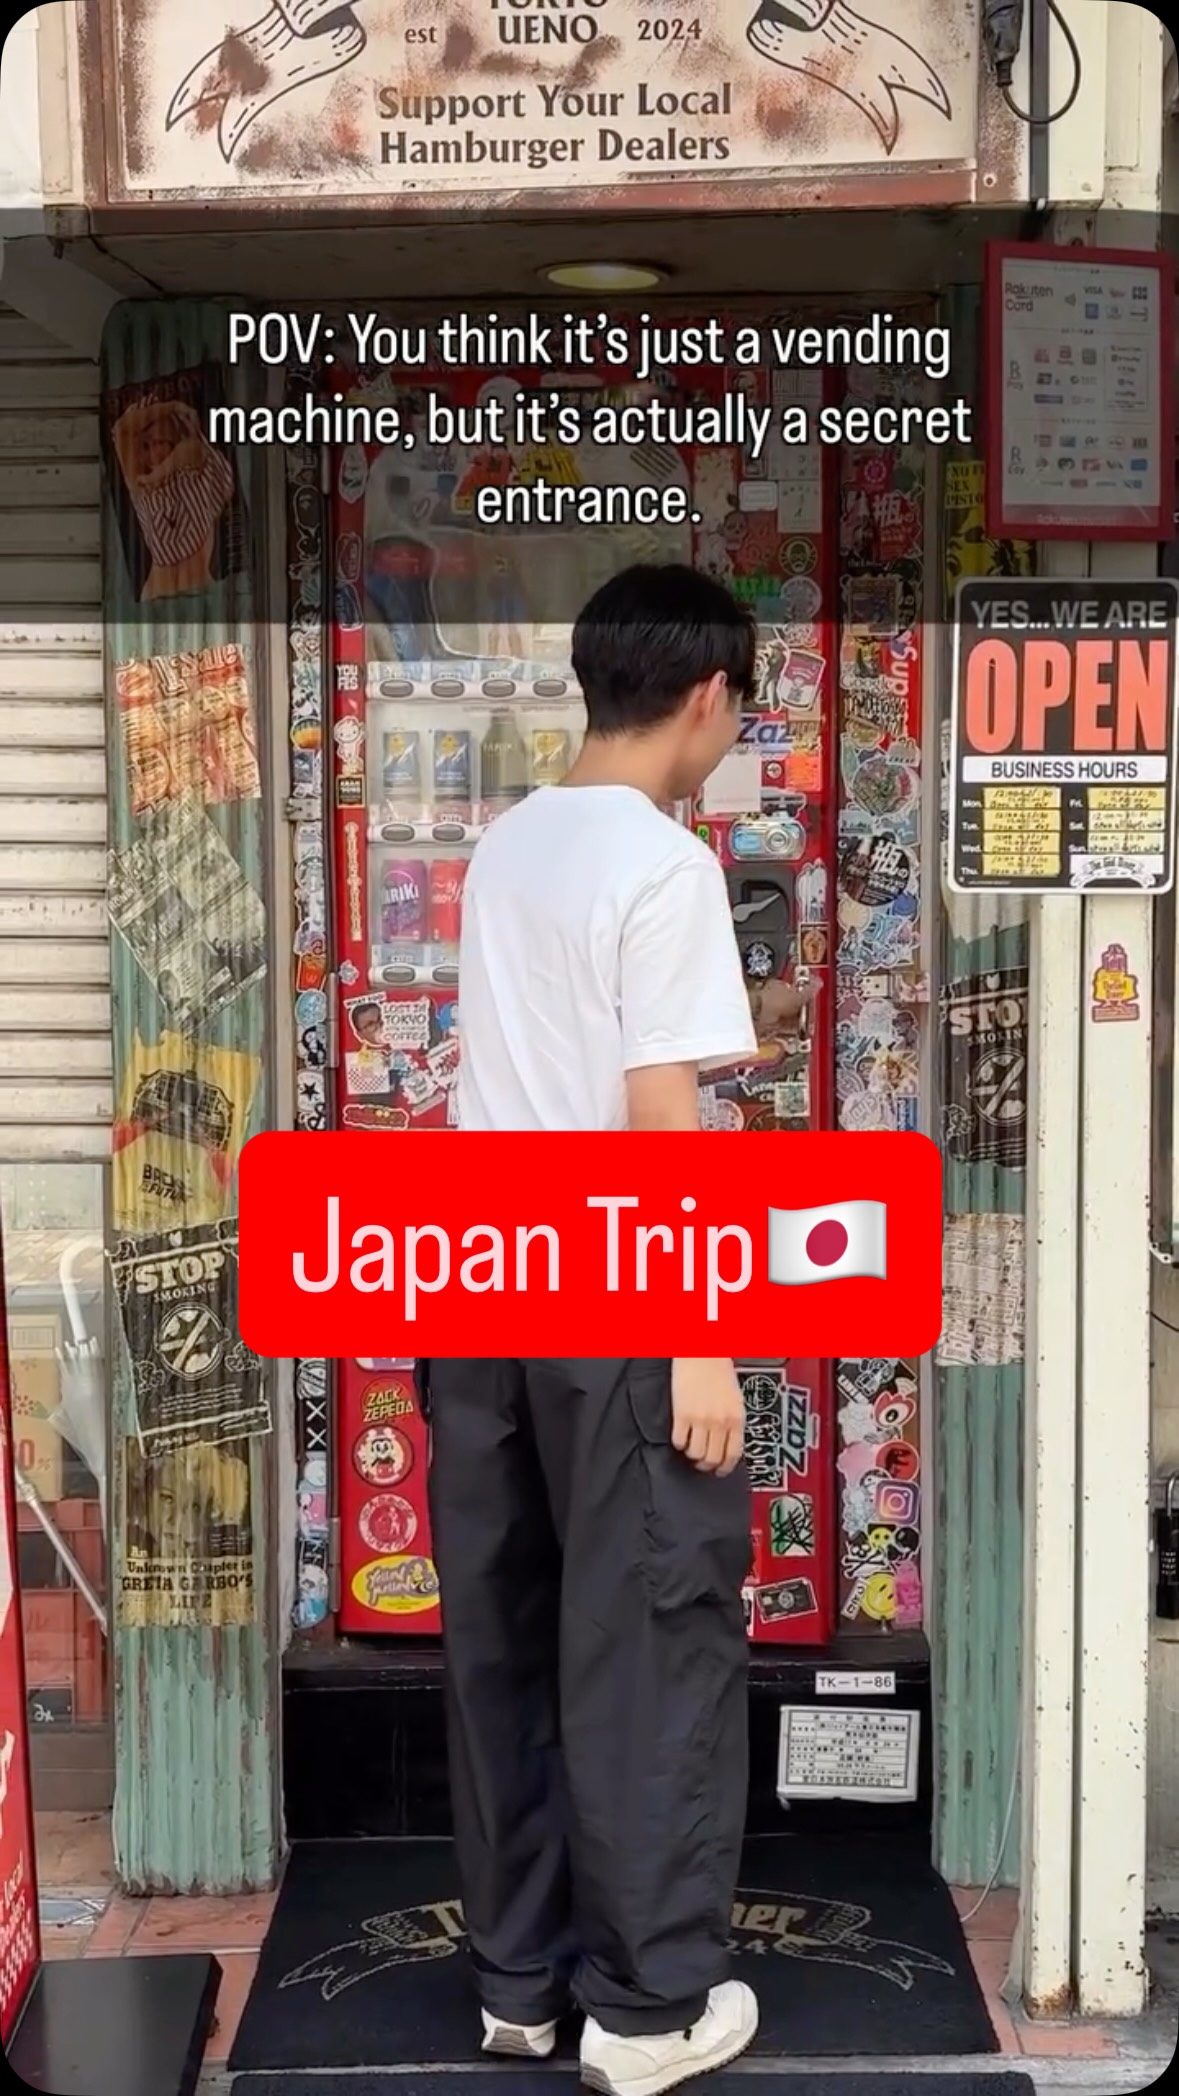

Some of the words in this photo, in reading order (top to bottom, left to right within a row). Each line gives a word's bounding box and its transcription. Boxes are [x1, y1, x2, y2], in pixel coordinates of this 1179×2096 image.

[405, 26, 437, 43] est
[498, 14, 599, 44] UENO
[637, 19, 702, 41] 2024
[379, 86, 525, 125] Support
[537, 84, 624, 117] Your
[637, 83, 731, 116] Local
[380, 130, 585, 169] Hamburger
[598, 127, 730, 162] Dealers
[1104, 600, 1168, 629] ARE
[966, 638, 1169, 754] OPEN
[991, 761, 1075, 778] BUSINESS
[1079, 761, 1139, 778] HOURS
[384, 1014, 426, 1024] TOKYO
[950, 998, 1028, 1036] STO
[135, 1251, 225, 1294] STOP
[153, 1283, 216, 1302] SMOKING
[367, 1388, 403, 1407] ZACK
[363, 1400, 414, 1422] ZEPEDA
[127, 1561, 186, 1573] Unknown
[122, 1576, 174, 1591] GRETA
